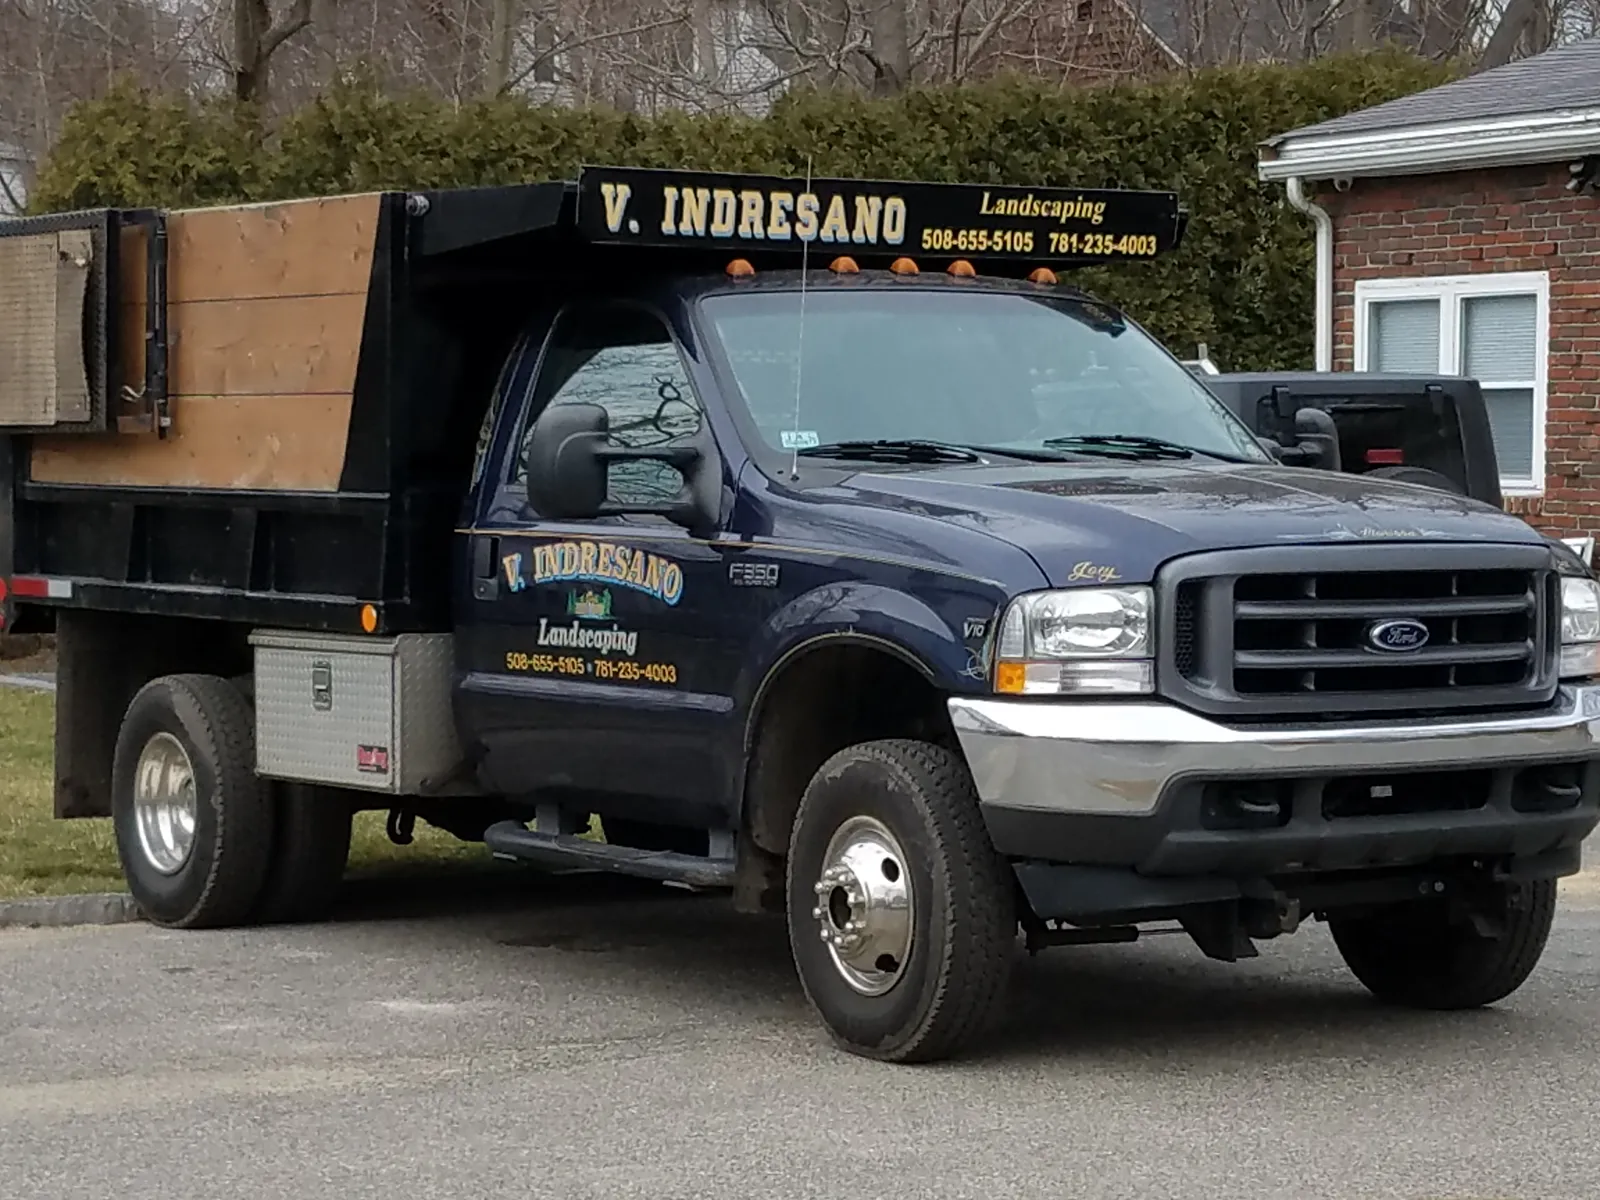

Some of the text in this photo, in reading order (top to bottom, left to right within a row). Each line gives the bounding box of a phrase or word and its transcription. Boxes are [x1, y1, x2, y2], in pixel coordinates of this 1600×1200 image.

[600, 183, 907, 245] V. INDRESANO
[979, 191, 1107, 225] Landscaping
[921, 228, 1157, 255] 508-655-5105 781-235-4003
[502, 541, 684, 606] V. INDRESANO
[729, 562, 780, 581] F350
[537, 617, 638, 656] Landscaping
[963, 621, 986, 638] V10
[1386, 626, 1418, 644] Ford
[506, 652, 677, 684] 508-655-5105 781-235-4003
